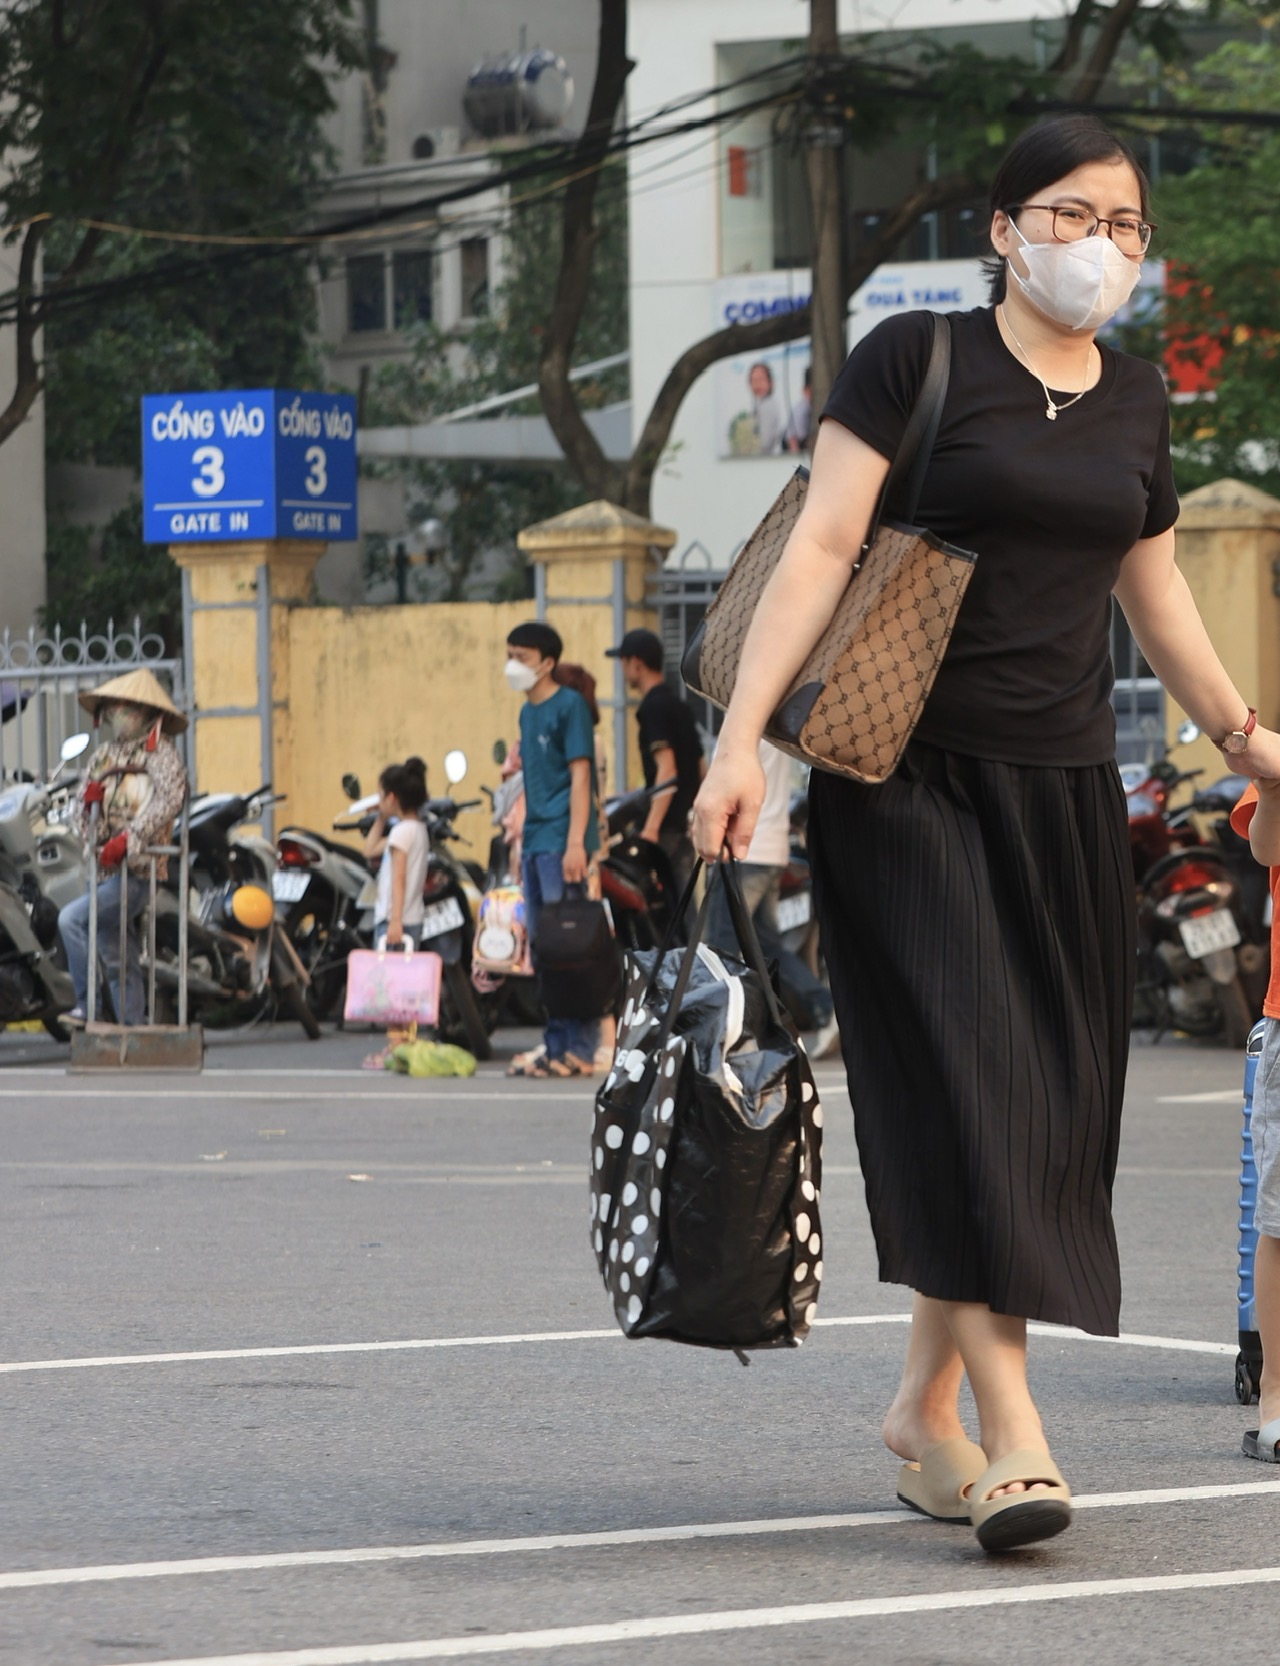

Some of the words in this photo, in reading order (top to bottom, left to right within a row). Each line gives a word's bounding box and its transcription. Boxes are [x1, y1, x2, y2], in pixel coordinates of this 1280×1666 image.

[724, 294, 812, 323] COMIN
[220, 401, 265, 438] VÀO
[323, 405, 352, 440] VÀO
[191, 446, 225, 495] 3
[305, 446, 327, 495] 3
[170, 512, 221, 534] GATE
[229, 512, 249, 531] IN
[293, 512, 325, 531] GATE
[327, 514, 341, 532] IN
